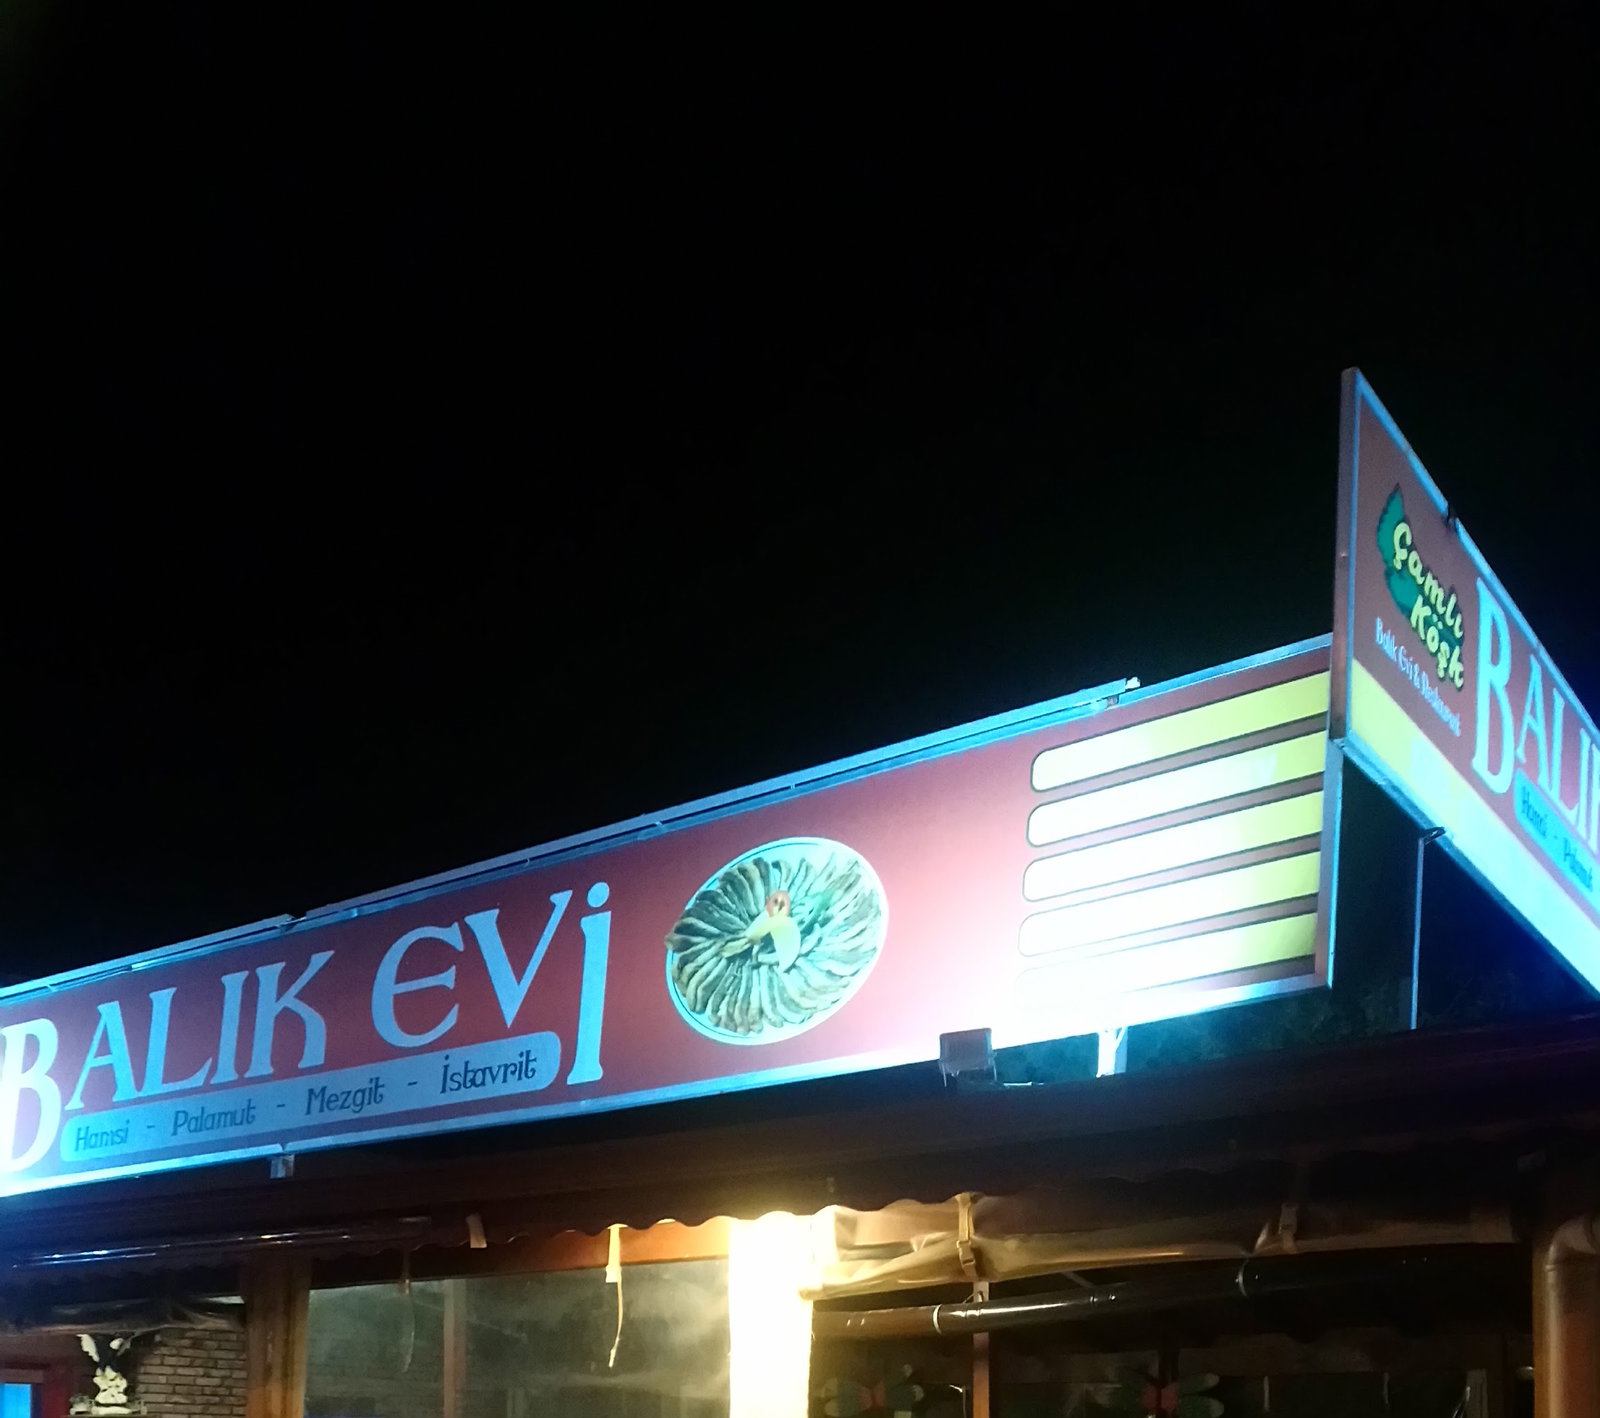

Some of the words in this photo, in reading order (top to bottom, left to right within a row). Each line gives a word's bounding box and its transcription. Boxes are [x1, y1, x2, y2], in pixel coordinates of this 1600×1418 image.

[1410, 594, 1464, 689] Köşk
[0, 950, 335, 1173] BALIK
[74, 1119, 130, 1152] Hamsi
[171, 1098, 256, 1137] Palamut
[305, 1076, 385, 1116] Mezgit
